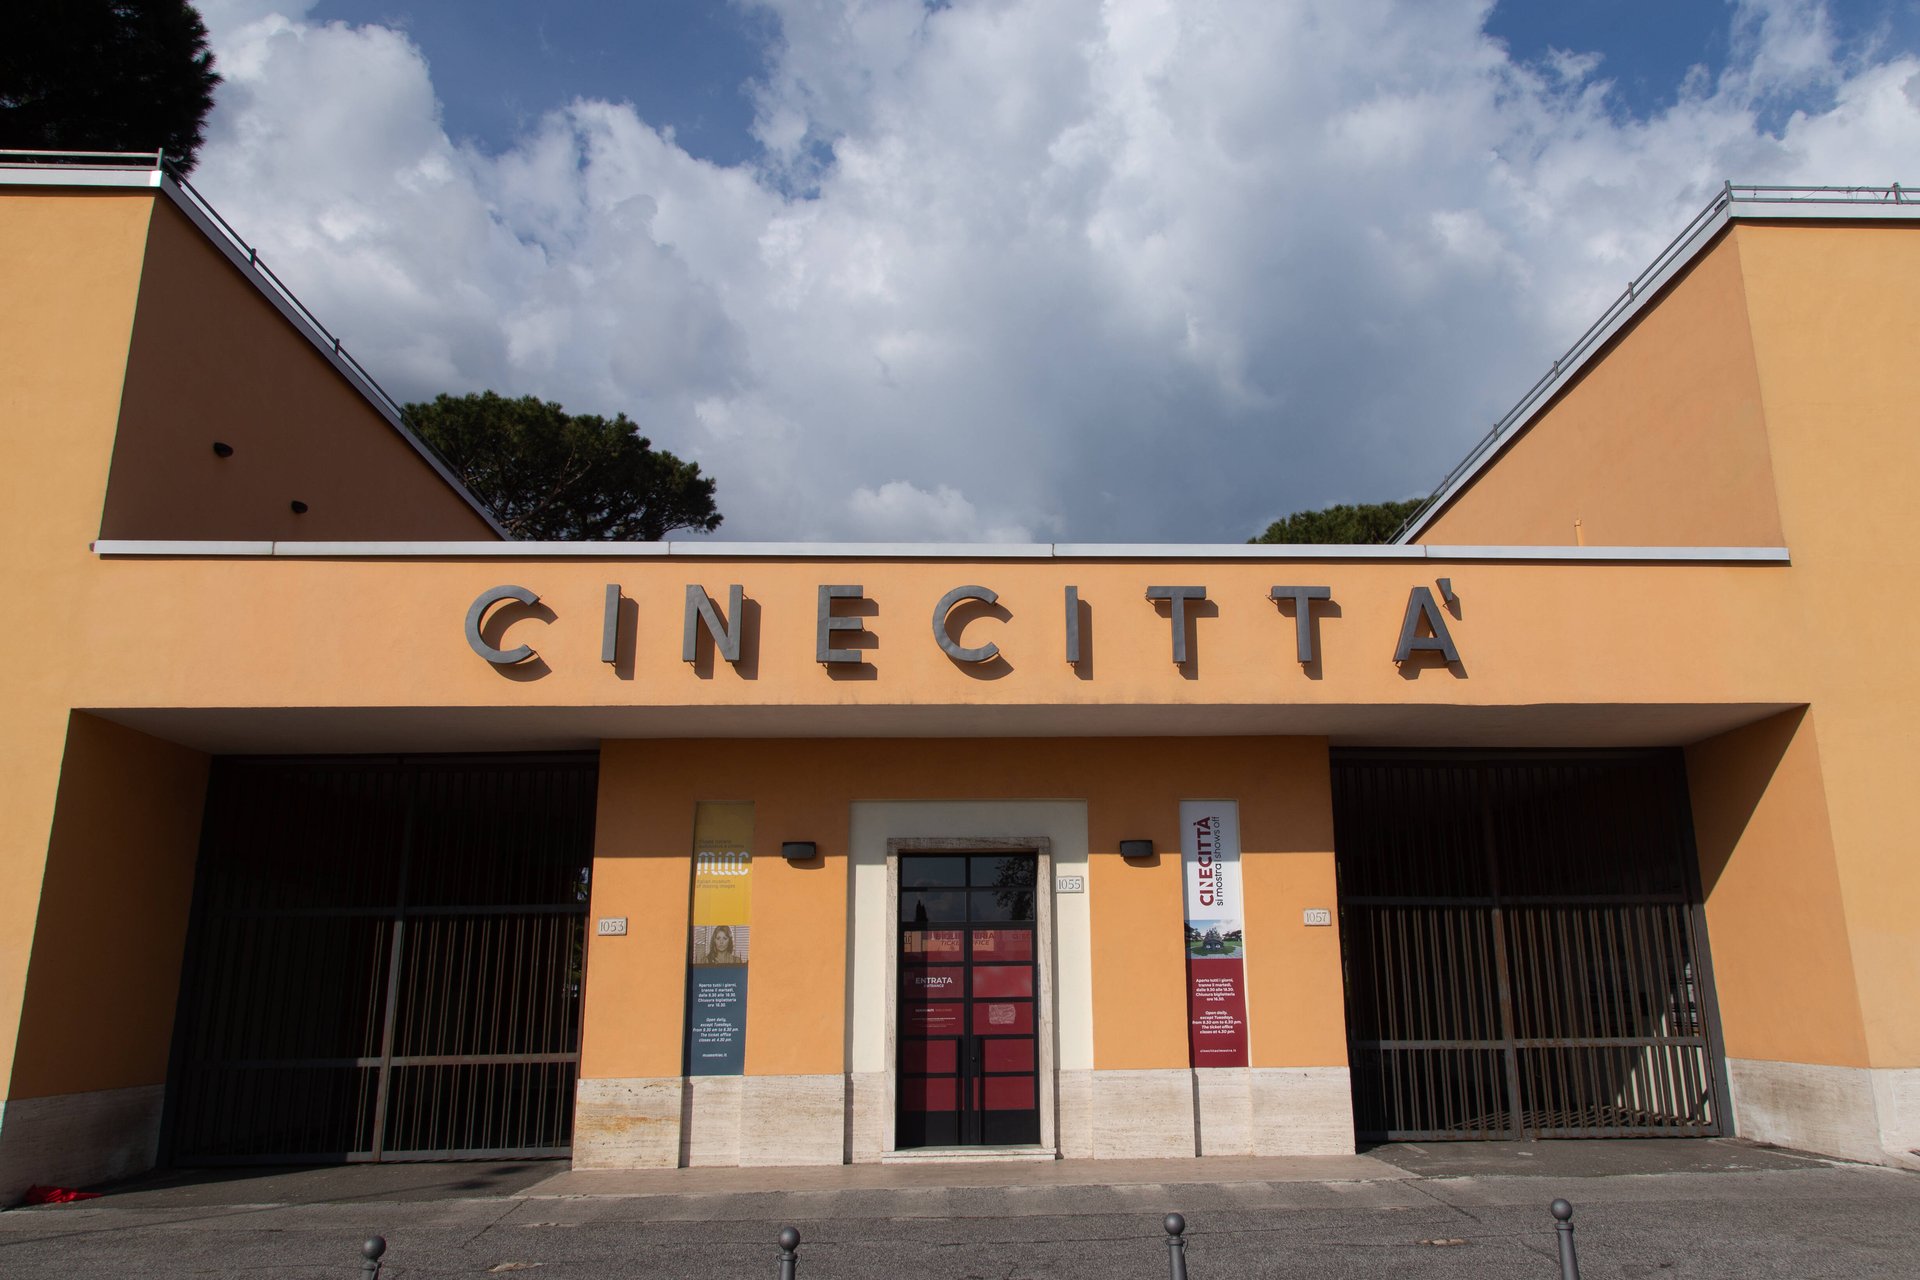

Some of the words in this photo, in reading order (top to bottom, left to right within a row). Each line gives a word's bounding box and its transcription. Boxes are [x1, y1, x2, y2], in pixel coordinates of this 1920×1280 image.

[465, 578, 1459, 664] CINECITTÀ
[1211, 816, 1220, 828] off
[1213, 829, 1222, 859] shows
[1193, 816, 1214, 906] CINECITTÀ
[1058, 878, 1080, 890] 1055
[1214, 863, 1223, 897] mostra
[600, 920, 624, 932] 1053
[1306, 912, 1328, 922] 1057
